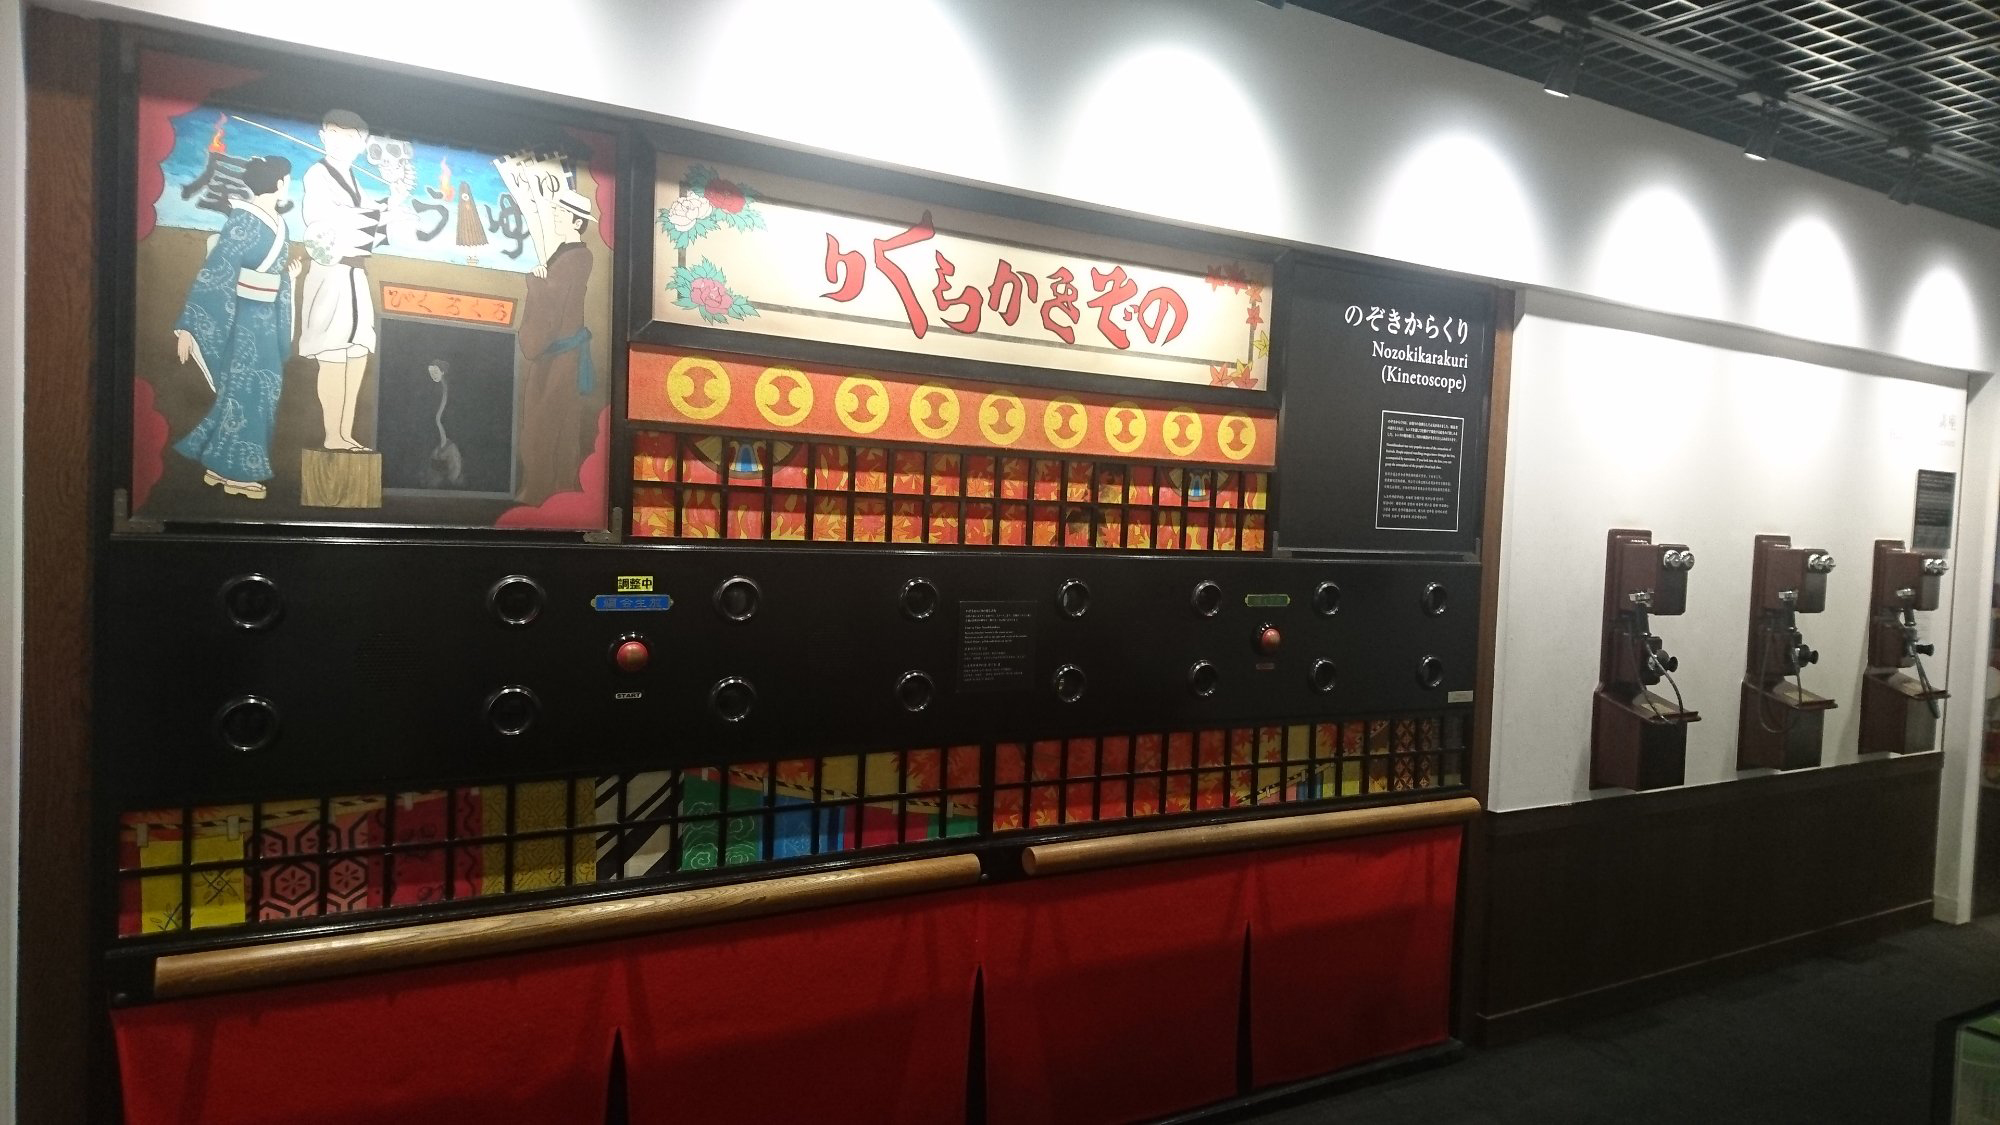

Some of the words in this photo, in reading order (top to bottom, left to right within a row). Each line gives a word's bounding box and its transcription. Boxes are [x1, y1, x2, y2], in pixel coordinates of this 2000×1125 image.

[1344, 305, 1469, 345] のぞきからくり
[1372, 340, 1469, 369] Nozokikarakuri
[1381, 364, 1467, 394] (Kinetoscope)
[617, 577, 653, 591] 調整中
